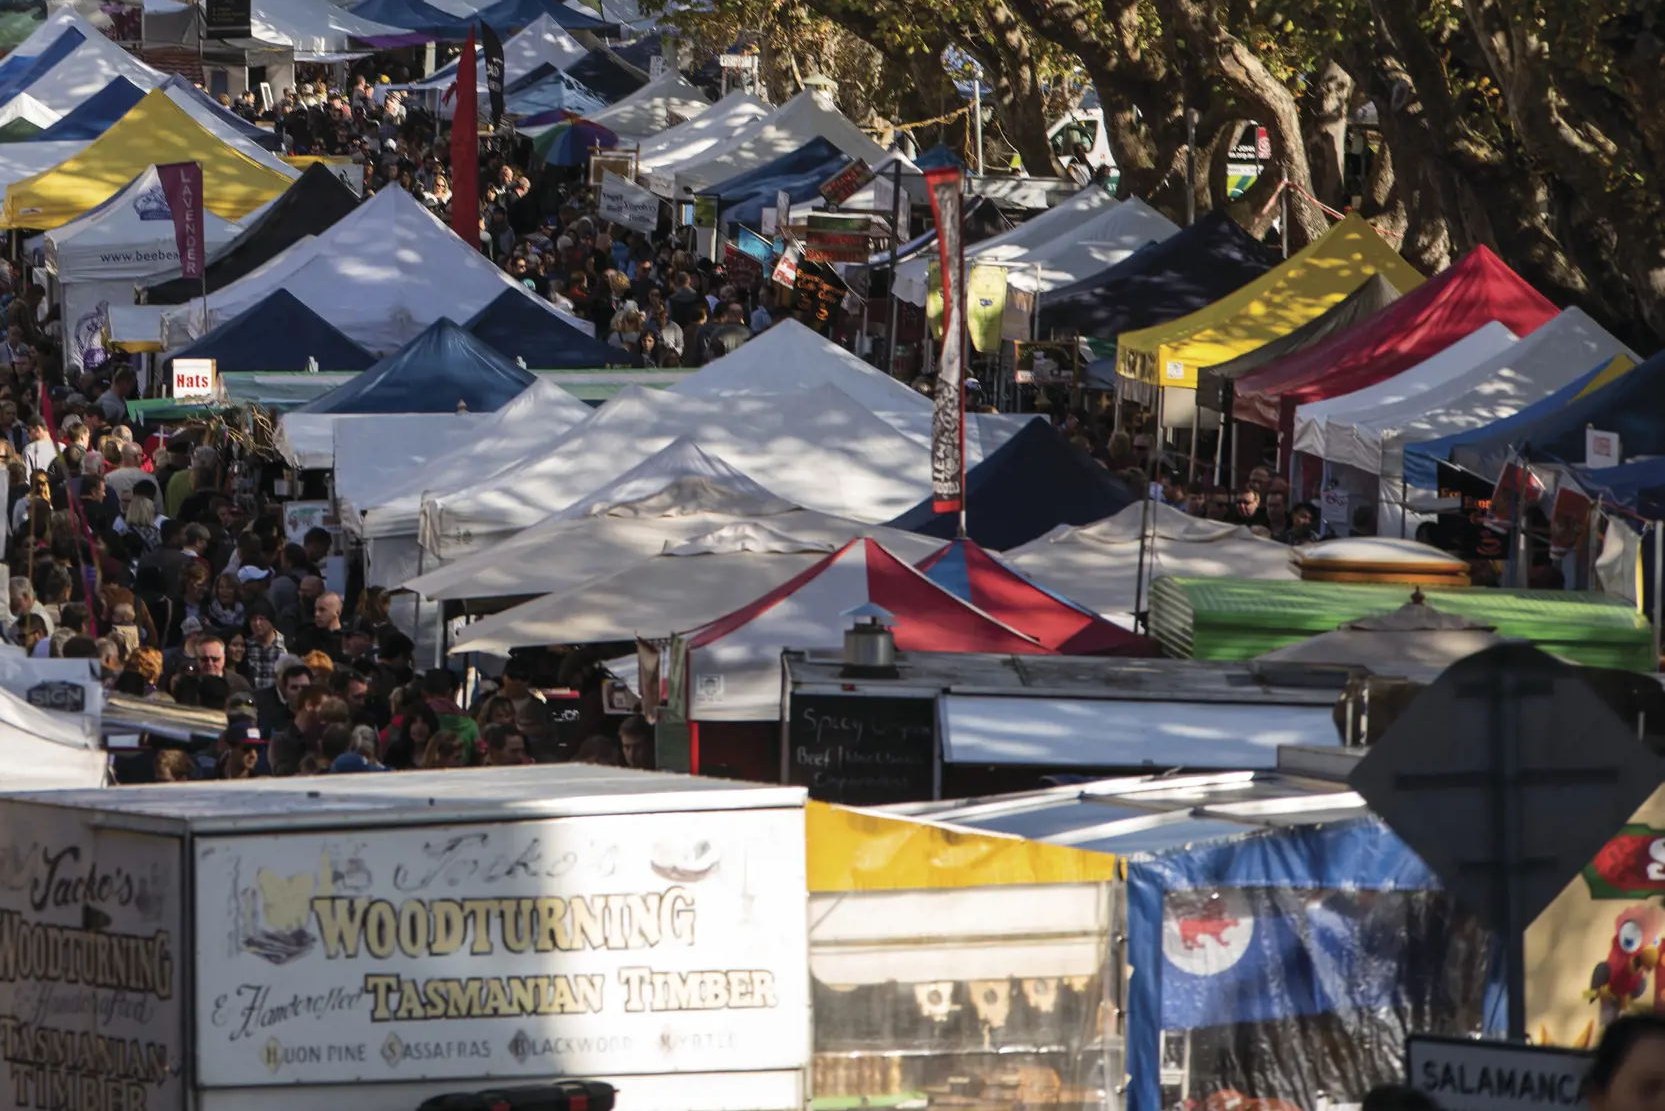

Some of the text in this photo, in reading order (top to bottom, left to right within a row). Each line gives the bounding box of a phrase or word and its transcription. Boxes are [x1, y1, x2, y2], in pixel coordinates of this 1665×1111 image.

[179, 169, 198, 274] LAVENDER
[177, 374, 209, 388] Hats
[31, 688, 82, 705] SIGN
[803, 708, 864, 743] Spicy
[796, 746, 831, 770] Beef
[30, 846, 134, 911] Jacko's
[309, 885, 696, 960] WOODTURNING
[229, 982, 367, 1041] Handcrafted
[364, 973, 605, 1023] TASMANIAN
[618, 965, 779, 1014] TIMBER
[261, 1037, 322, 1073] HUON
[327, 1043, 366, 1064] PINE
[383, 1033, 492, 1067] SASSAFRAS
[508, 1030, 632, 1063] BLACKWOOD
[9, 1064, 148, 1111] TIMBER
